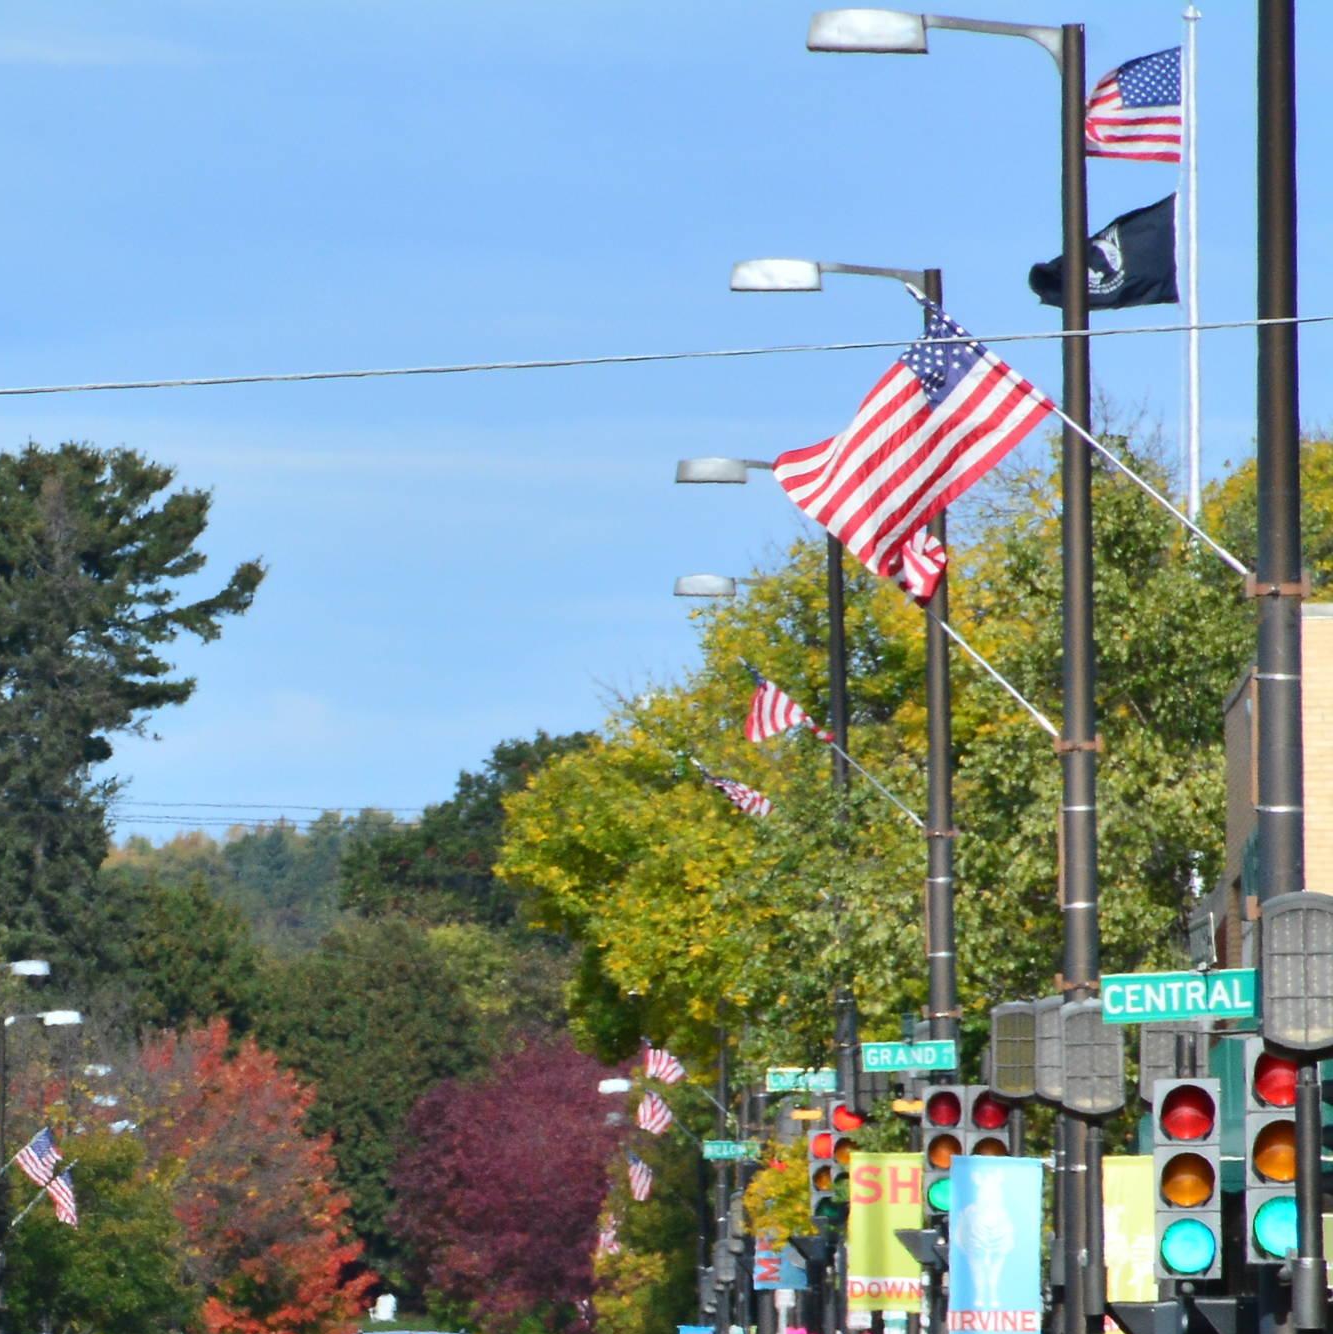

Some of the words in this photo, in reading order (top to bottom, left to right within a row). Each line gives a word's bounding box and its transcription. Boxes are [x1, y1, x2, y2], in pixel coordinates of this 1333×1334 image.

[1103, 980, 1252, 1014] CENTRAL
[867, 1046, 937, 1066] GRAND
[853, 1164, 923, 1204] SH
[848, 1280, 924, 1300] DOWN
[950, 1310, 1036, 1332] IRVINE
